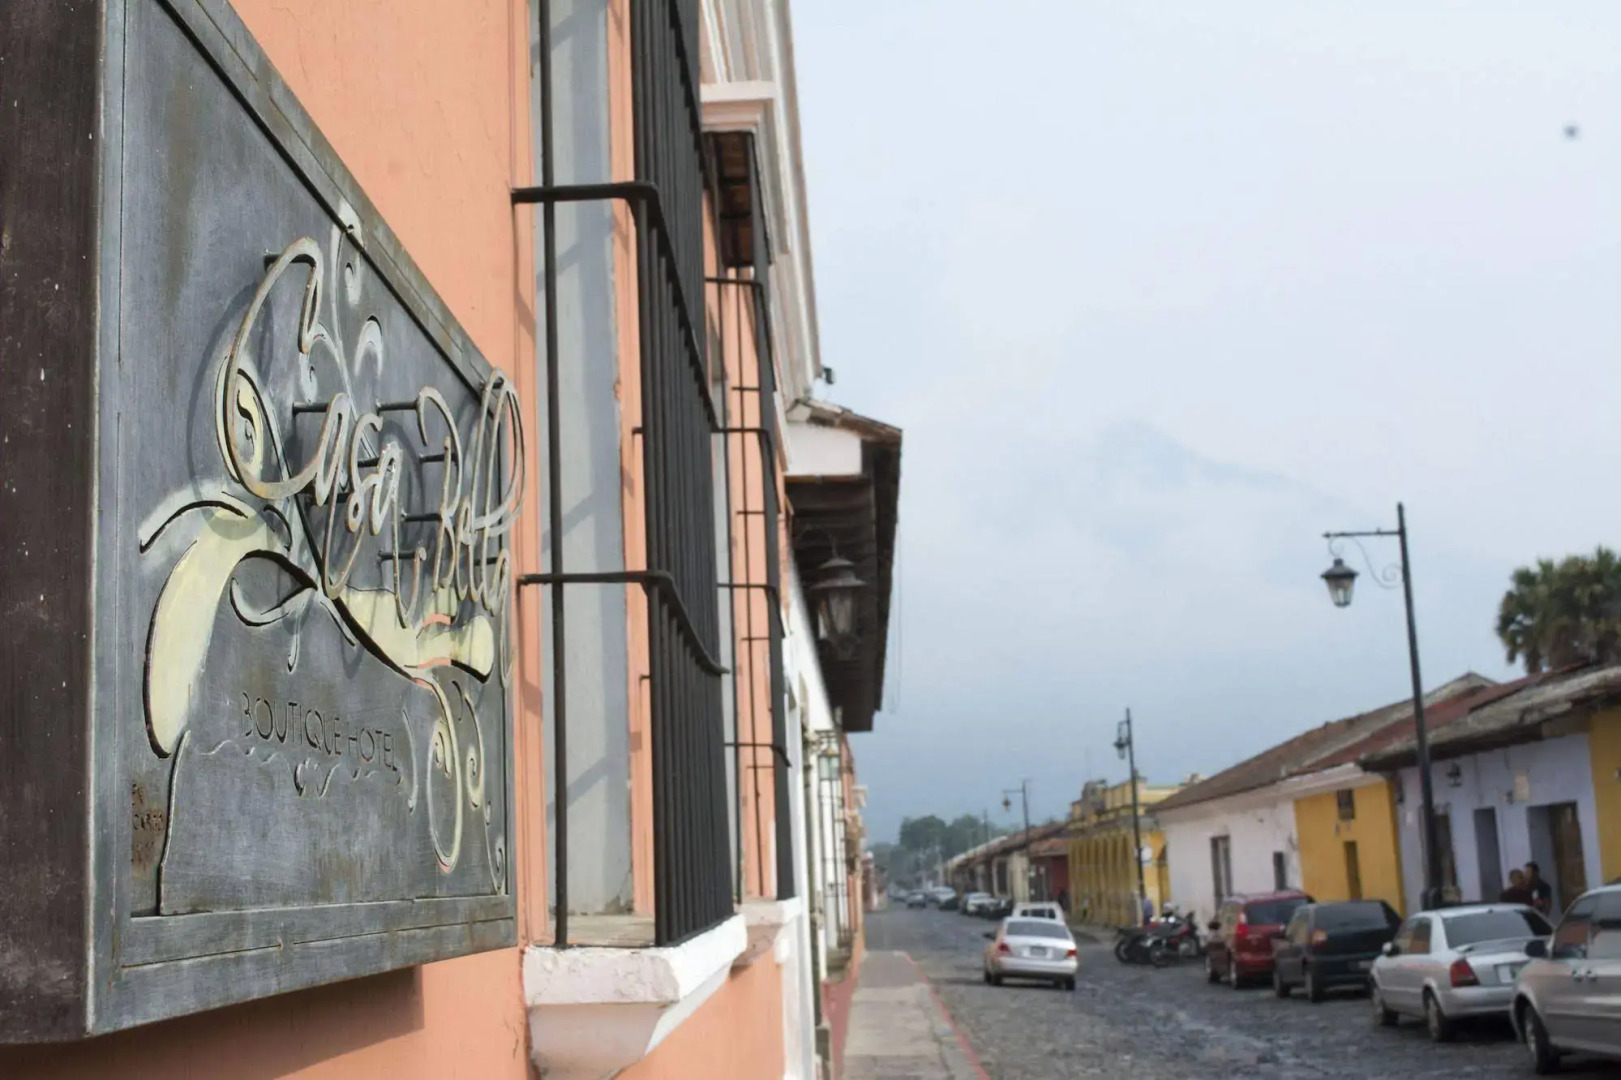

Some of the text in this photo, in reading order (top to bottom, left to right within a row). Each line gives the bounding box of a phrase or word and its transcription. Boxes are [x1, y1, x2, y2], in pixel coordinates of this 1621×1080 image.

[224, 237, 525, 688] Casa Bella
[241, 691, 398, 772] BOUTIQUE HOTEL
